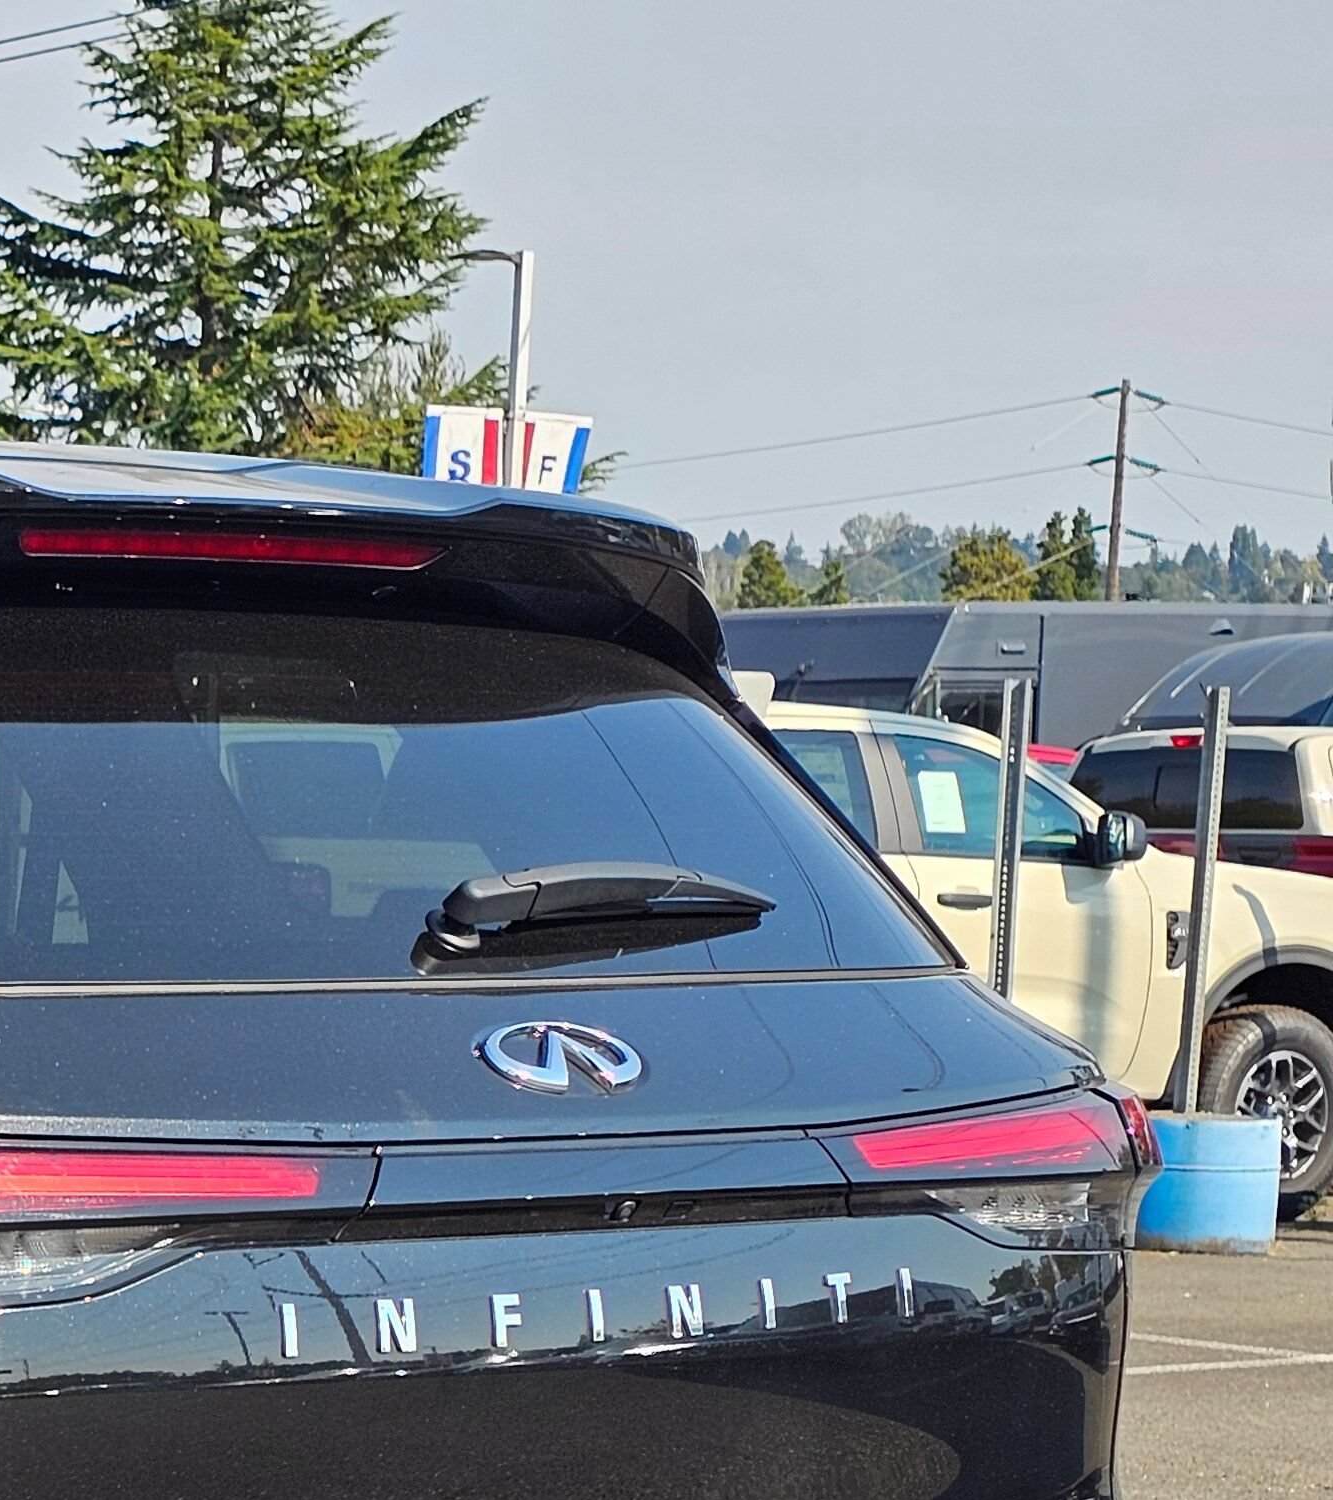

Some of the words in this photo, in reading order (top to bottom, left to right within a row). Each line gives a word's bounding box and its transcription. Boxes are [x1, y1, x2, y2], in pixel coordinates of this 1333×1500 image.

[448, 449, 471, 482] S
[538, 455, 557, 485] F
[279, 1267, 916, 1359] INFINITI
